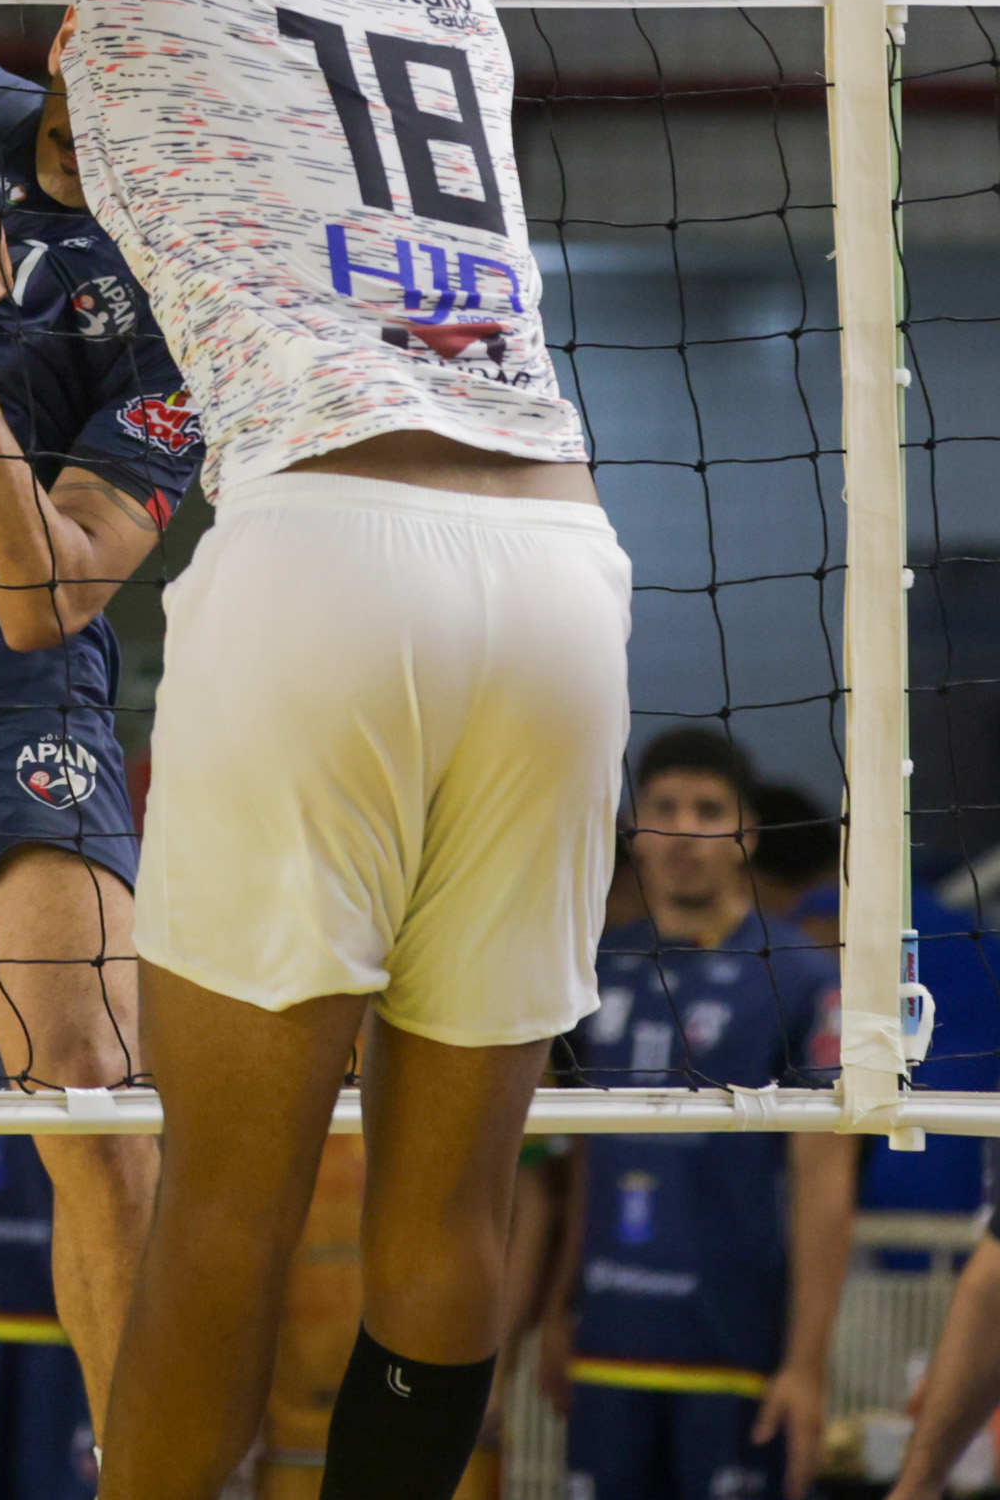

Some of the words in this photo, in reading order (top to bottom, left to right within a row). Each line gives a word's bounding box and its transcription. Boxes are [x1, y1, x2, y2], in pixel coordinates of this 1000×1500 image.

[276, 7, 509, 237] 18
[90, 275, 137, 335] APAN
[18, 742, 98, 775] APAN
